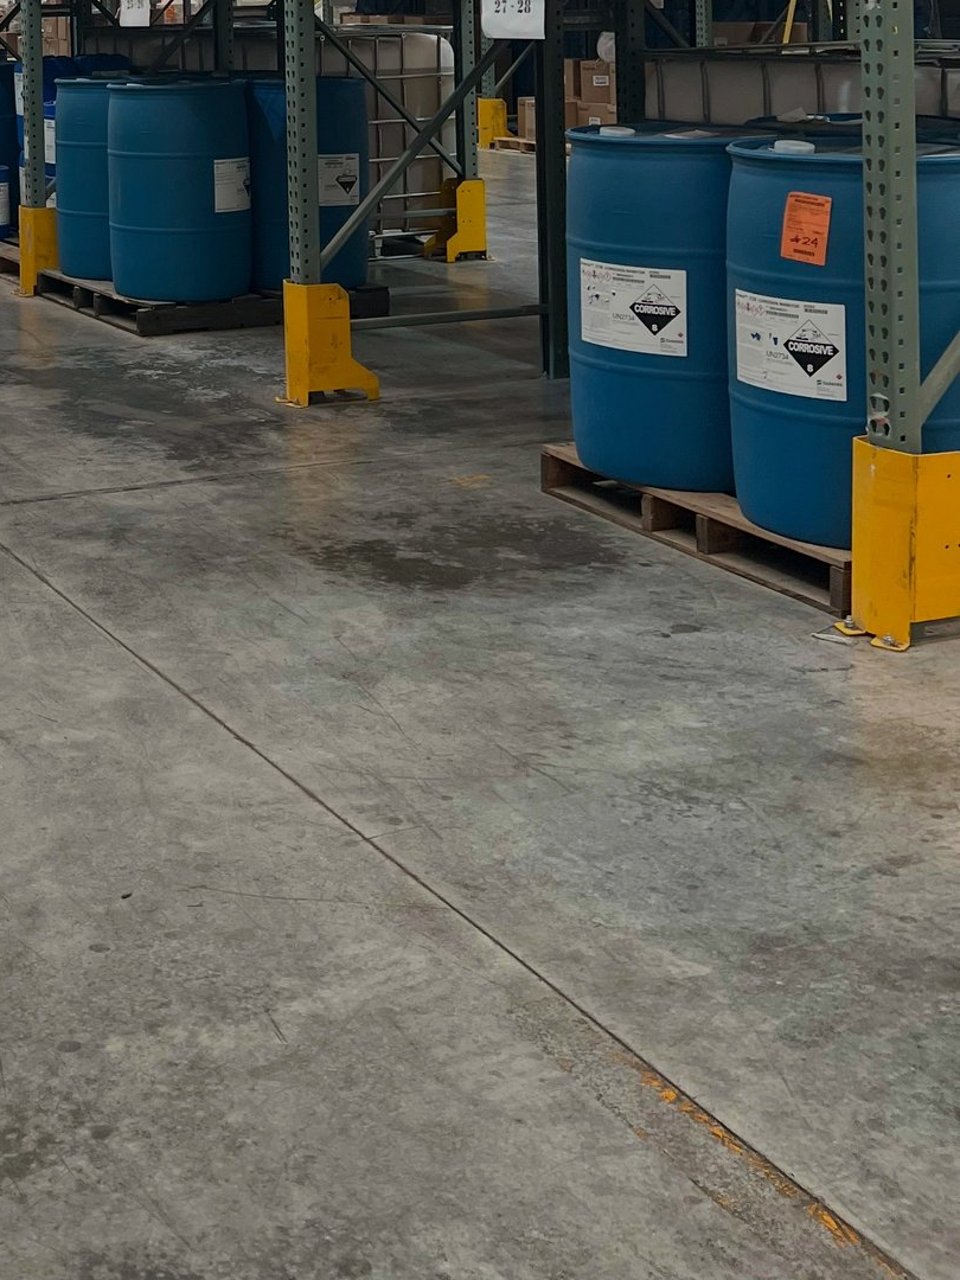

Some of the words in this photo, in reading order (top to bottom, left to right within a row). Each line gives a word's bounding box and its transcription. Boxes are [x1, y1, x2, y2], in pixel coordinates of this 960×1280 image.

[494, 0, 507, 14] 27
[517, 0, 531, 14] 28
[634, 304, 676, 317] CORROSIVE
[651, 324, 658, 332] 8
[788, 341, 834, 356] CORROSIVE
[806, 363, 814, 373] 8
